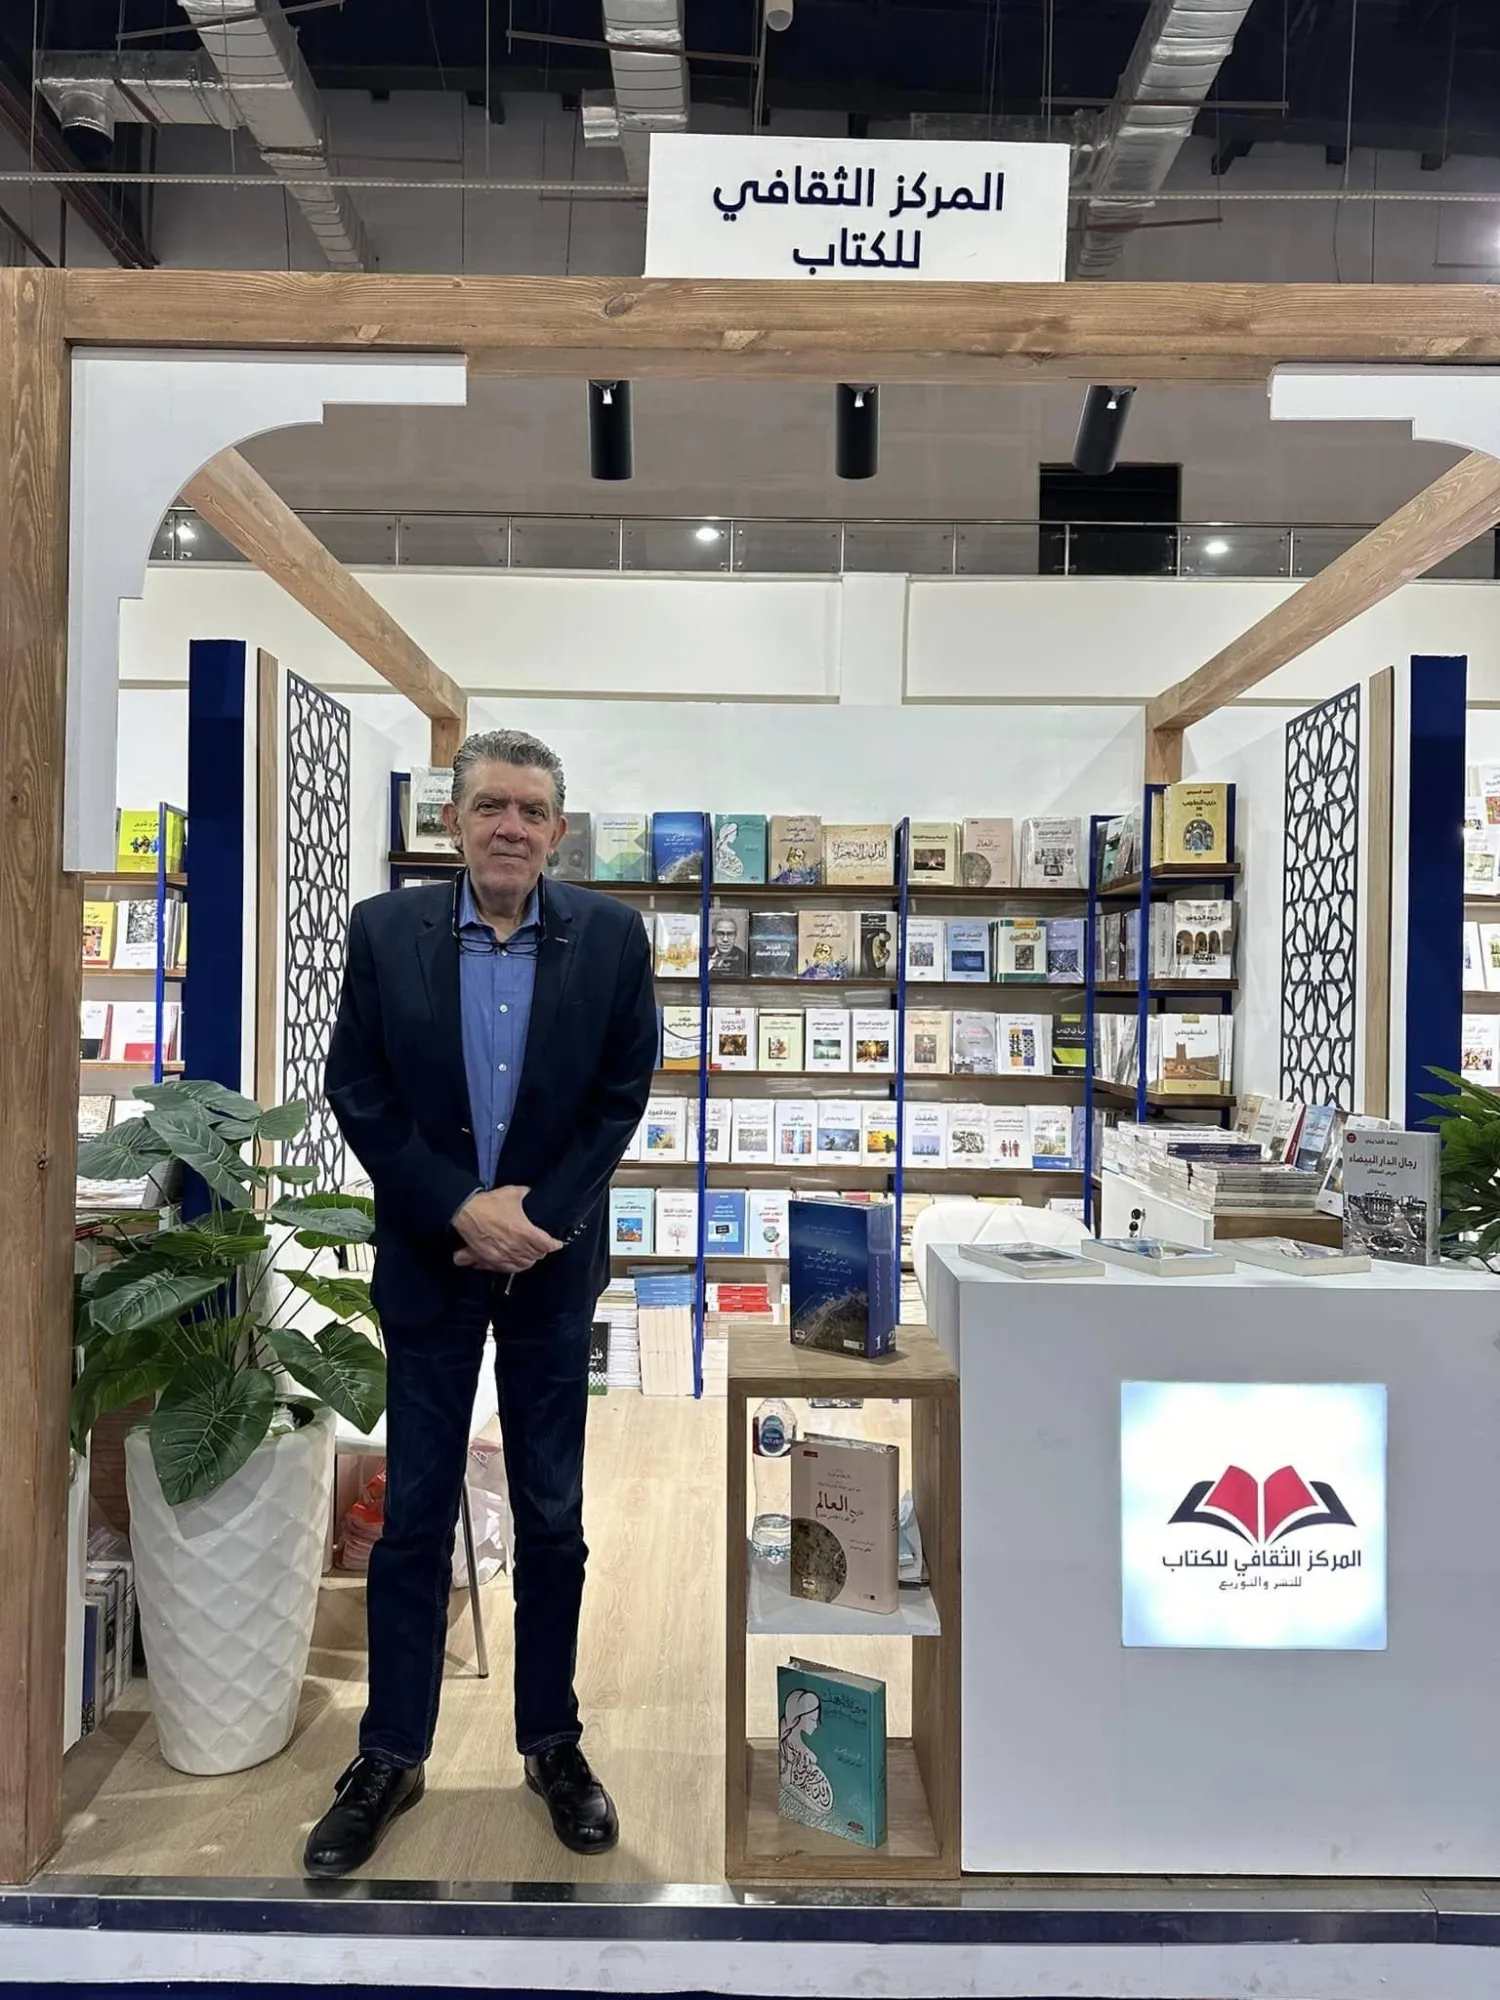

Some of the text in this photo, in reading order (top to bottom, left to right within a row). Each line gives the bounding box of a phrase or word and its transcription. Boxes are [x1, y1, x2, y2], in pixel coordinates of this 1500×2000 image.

[713, 165, 1005, 222] المركز الثقافي
[792, 227, 922, 275] للكتاب
[1349, 1153, 1417, 1170] رجال الدار البيضاء
[875, 1335, 882, 1350] 1
[888, 1330, 895, 1346] 2
[815, 1491, 848, 1518] العالم
[1162, 1545, 1362, 1577] المركز الثقافي للكتاب
[1218, 1576, 1302, 1591] للنشر والتوزيع
